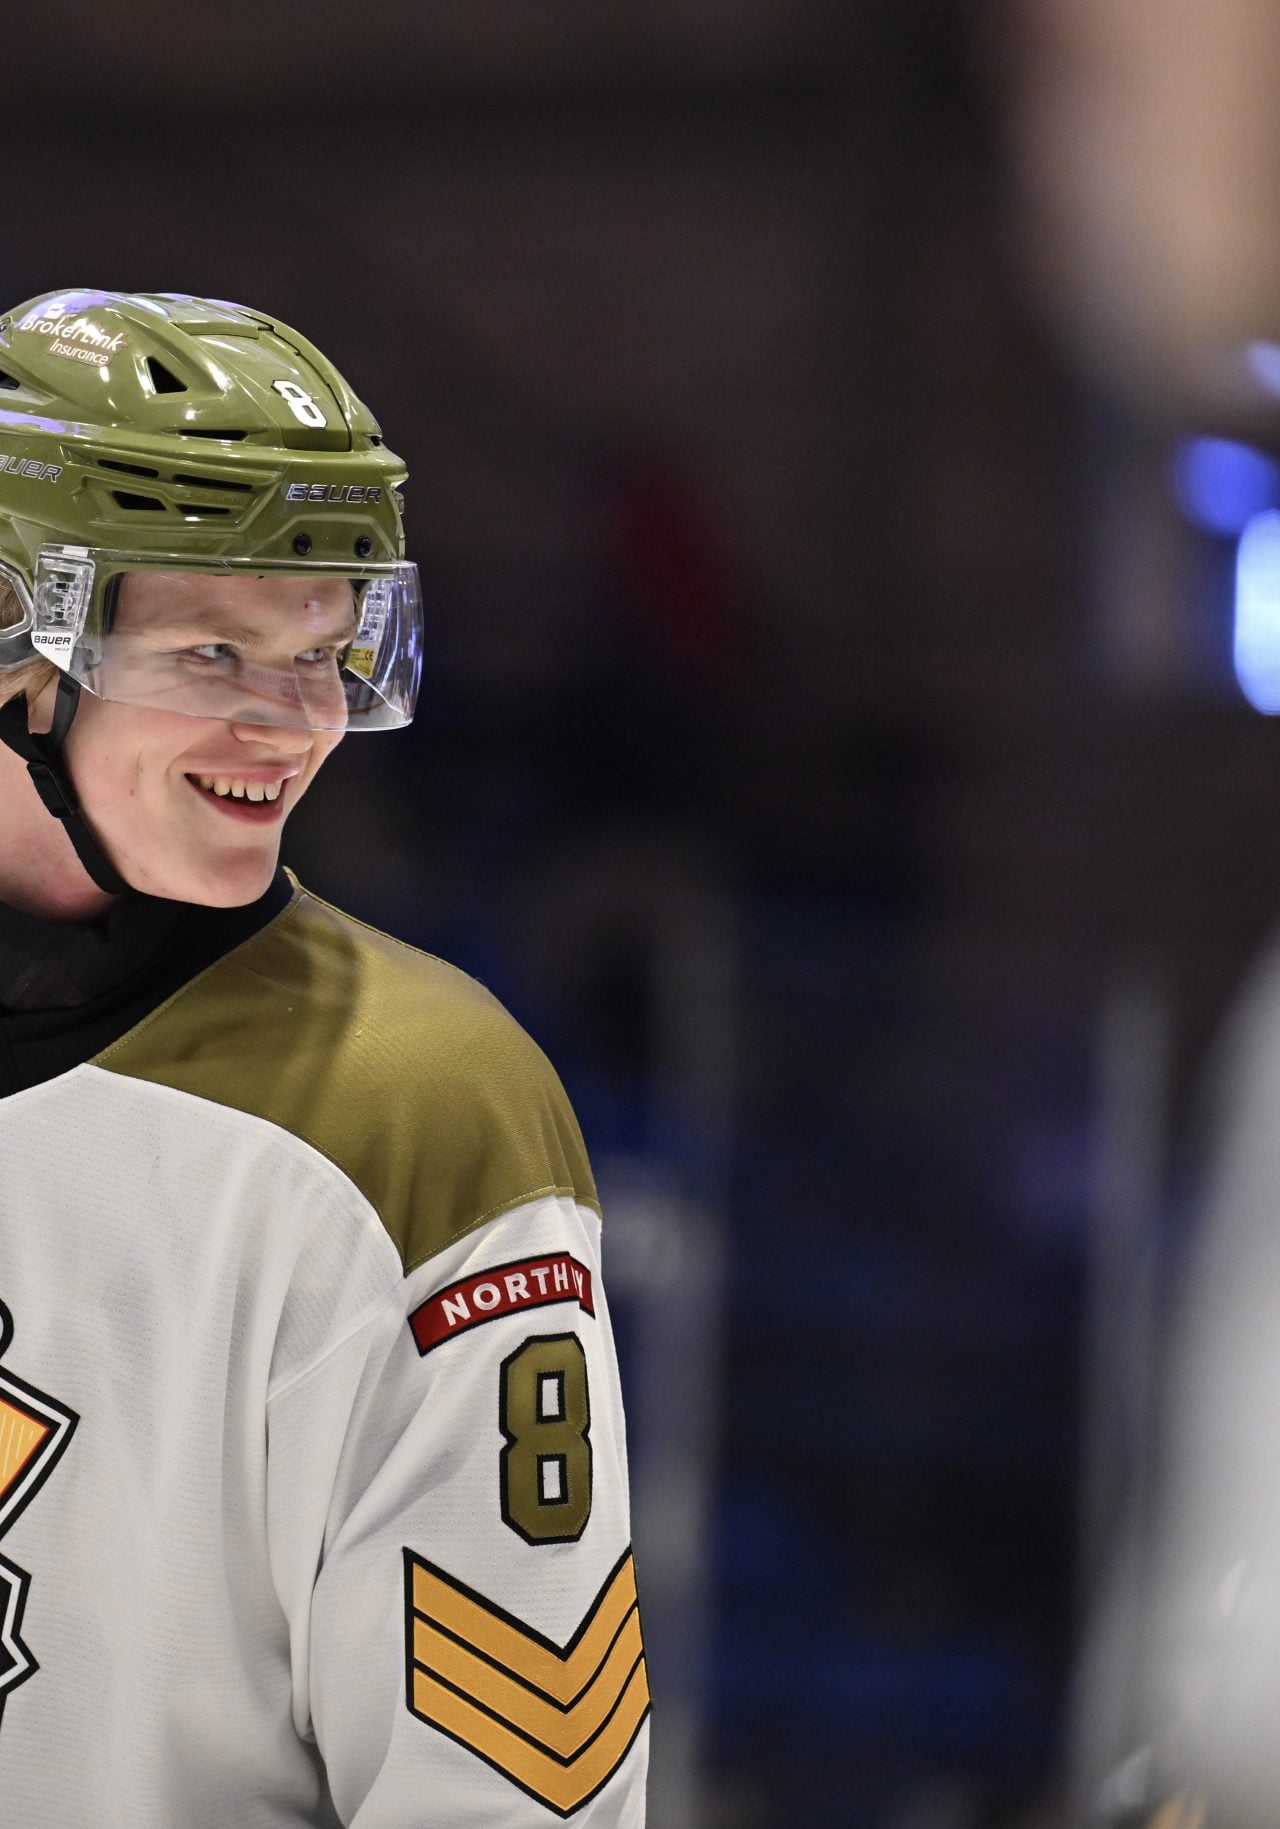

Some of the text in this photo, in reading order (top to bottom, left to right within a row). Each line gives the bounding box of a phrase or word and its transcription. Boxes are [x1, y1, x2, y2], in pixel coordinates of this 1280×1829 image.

[49, 338, 109, 365] Insurance
[271, 380, 328, 429] 8
[286, 483, 382, 503] BAUER
[33, 635, 72, 646] BAUER
[440, 1262, 570, 1327] NORTH
[498, 1331, 594, 1546] 8
